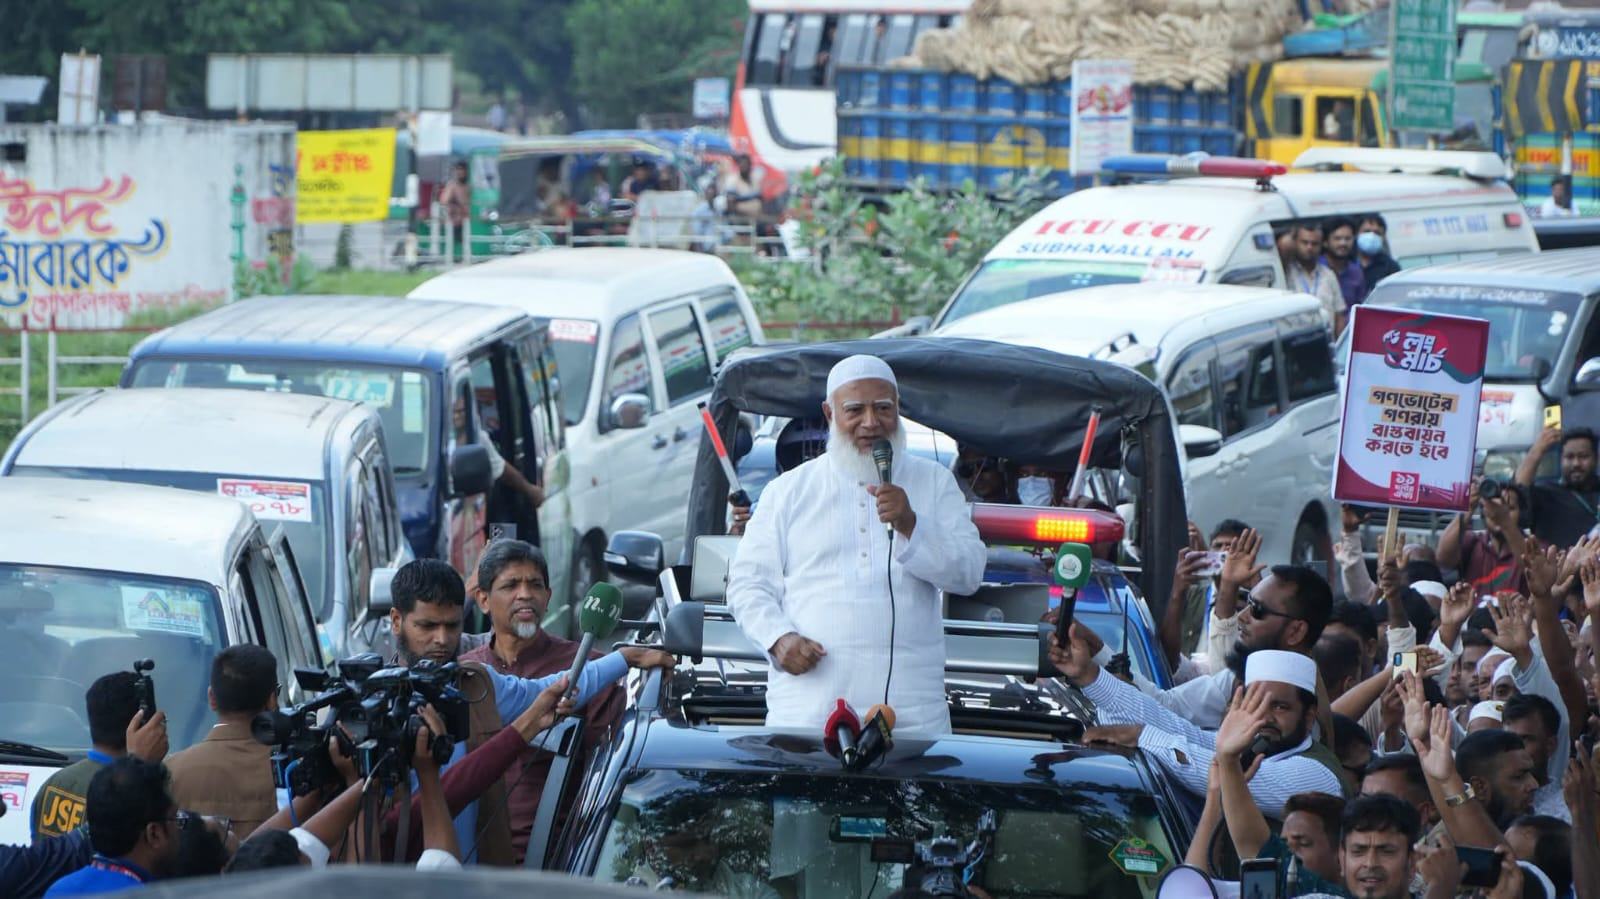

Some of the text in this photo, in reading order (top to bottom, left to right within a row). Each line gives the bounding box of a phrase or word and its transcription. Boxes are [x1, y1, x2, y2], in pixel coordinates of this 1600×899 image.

[1034, 219, 1211, 241] ICU CCU
[1017, 241, 1193, 259] SUBHANALLAH
[1372, 389, 1454, 412] গণভোটের
[1383, 407, 1441, 428] গণরায়
[1371, 423, 1447, 444] বাস্তবায়ন
[1364, 438, 1450, 460] করতে হবে
